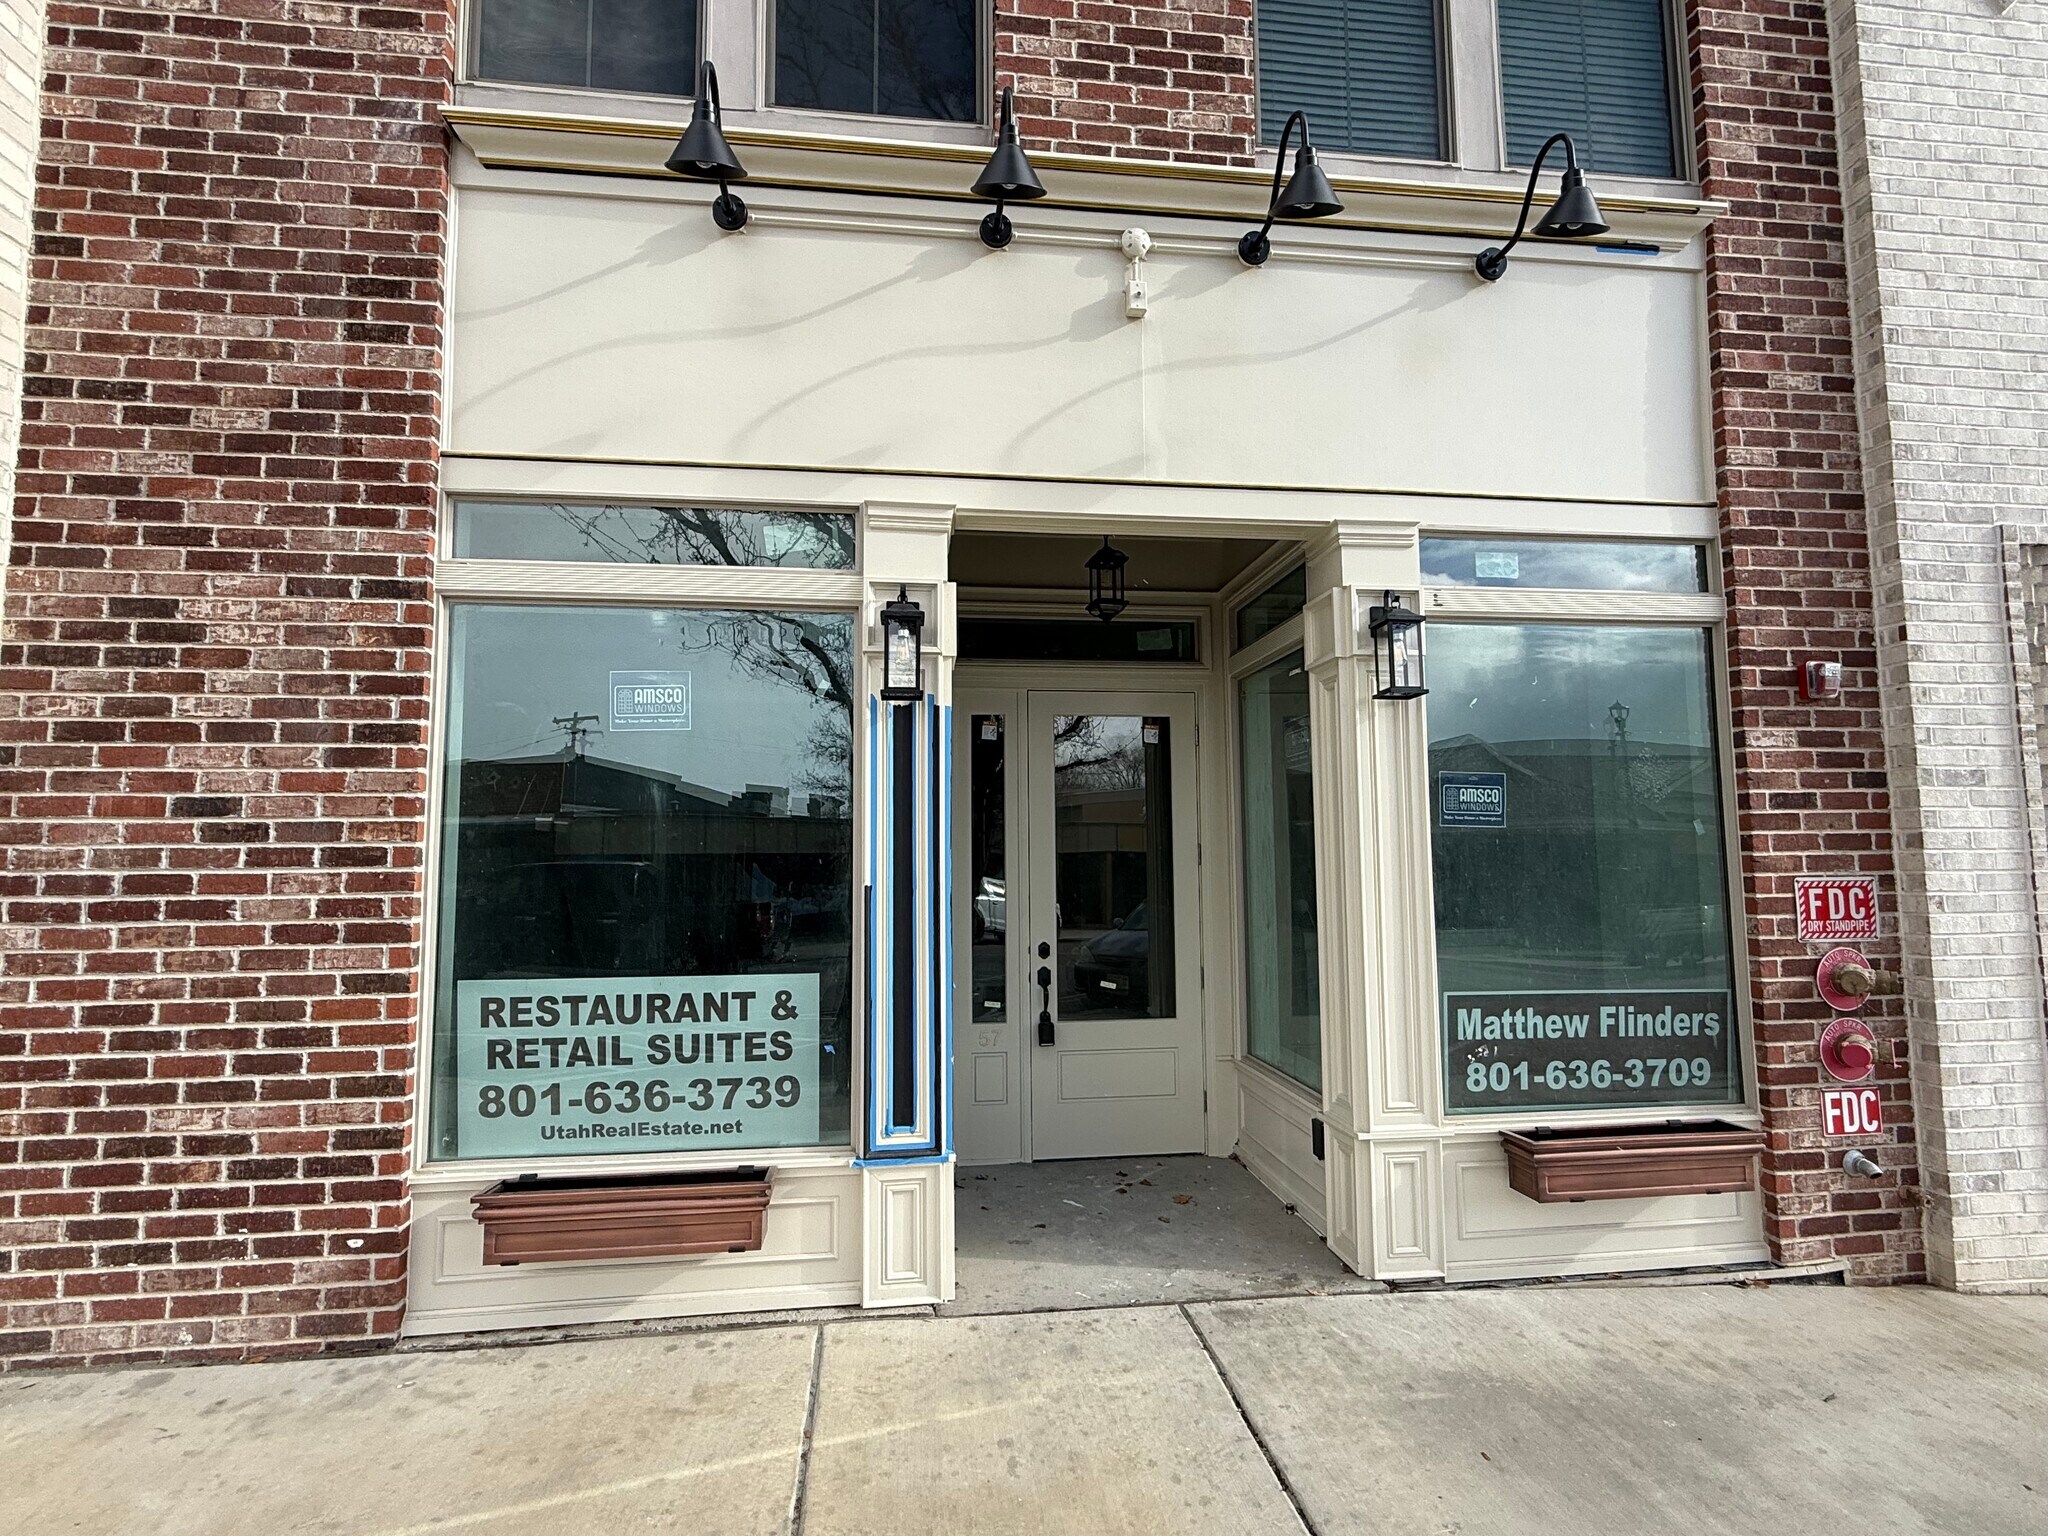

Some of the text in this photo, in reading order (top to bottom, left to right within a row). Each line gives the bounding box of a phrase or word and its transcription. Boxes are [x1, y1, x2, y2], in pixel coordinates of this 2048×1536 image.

[634, 688, 682, 704] AMSCO
[634, 704, 683, 713] WINDOWS
[1459, 788, 1499, 803] AMSCO
[1459, 802, 1500, 811] WINDOWS
[1808, 887, 1866, 920] FDC
[1807, 919, 1870, 932] DRY STANDPIPE
[1823, 951, 1840, 968] AUTO
[480, 989, 799, 1028] RESTAURANT &
[1457, 1005, 1720, 1041] Matthew Flinders
[1824, 1023, 1840, 1042] AUTO
[486, 1031, 793, 1070] RETAIL SUITES
[1466, 1057, 1712, 1093] 801-636-3709
[478, 1075, 801, 1119] 801-636-3739
[1824, 1090, 1878, 1134] FDC
[540, 1119, 743, 1141] UtahRealEstate.net
